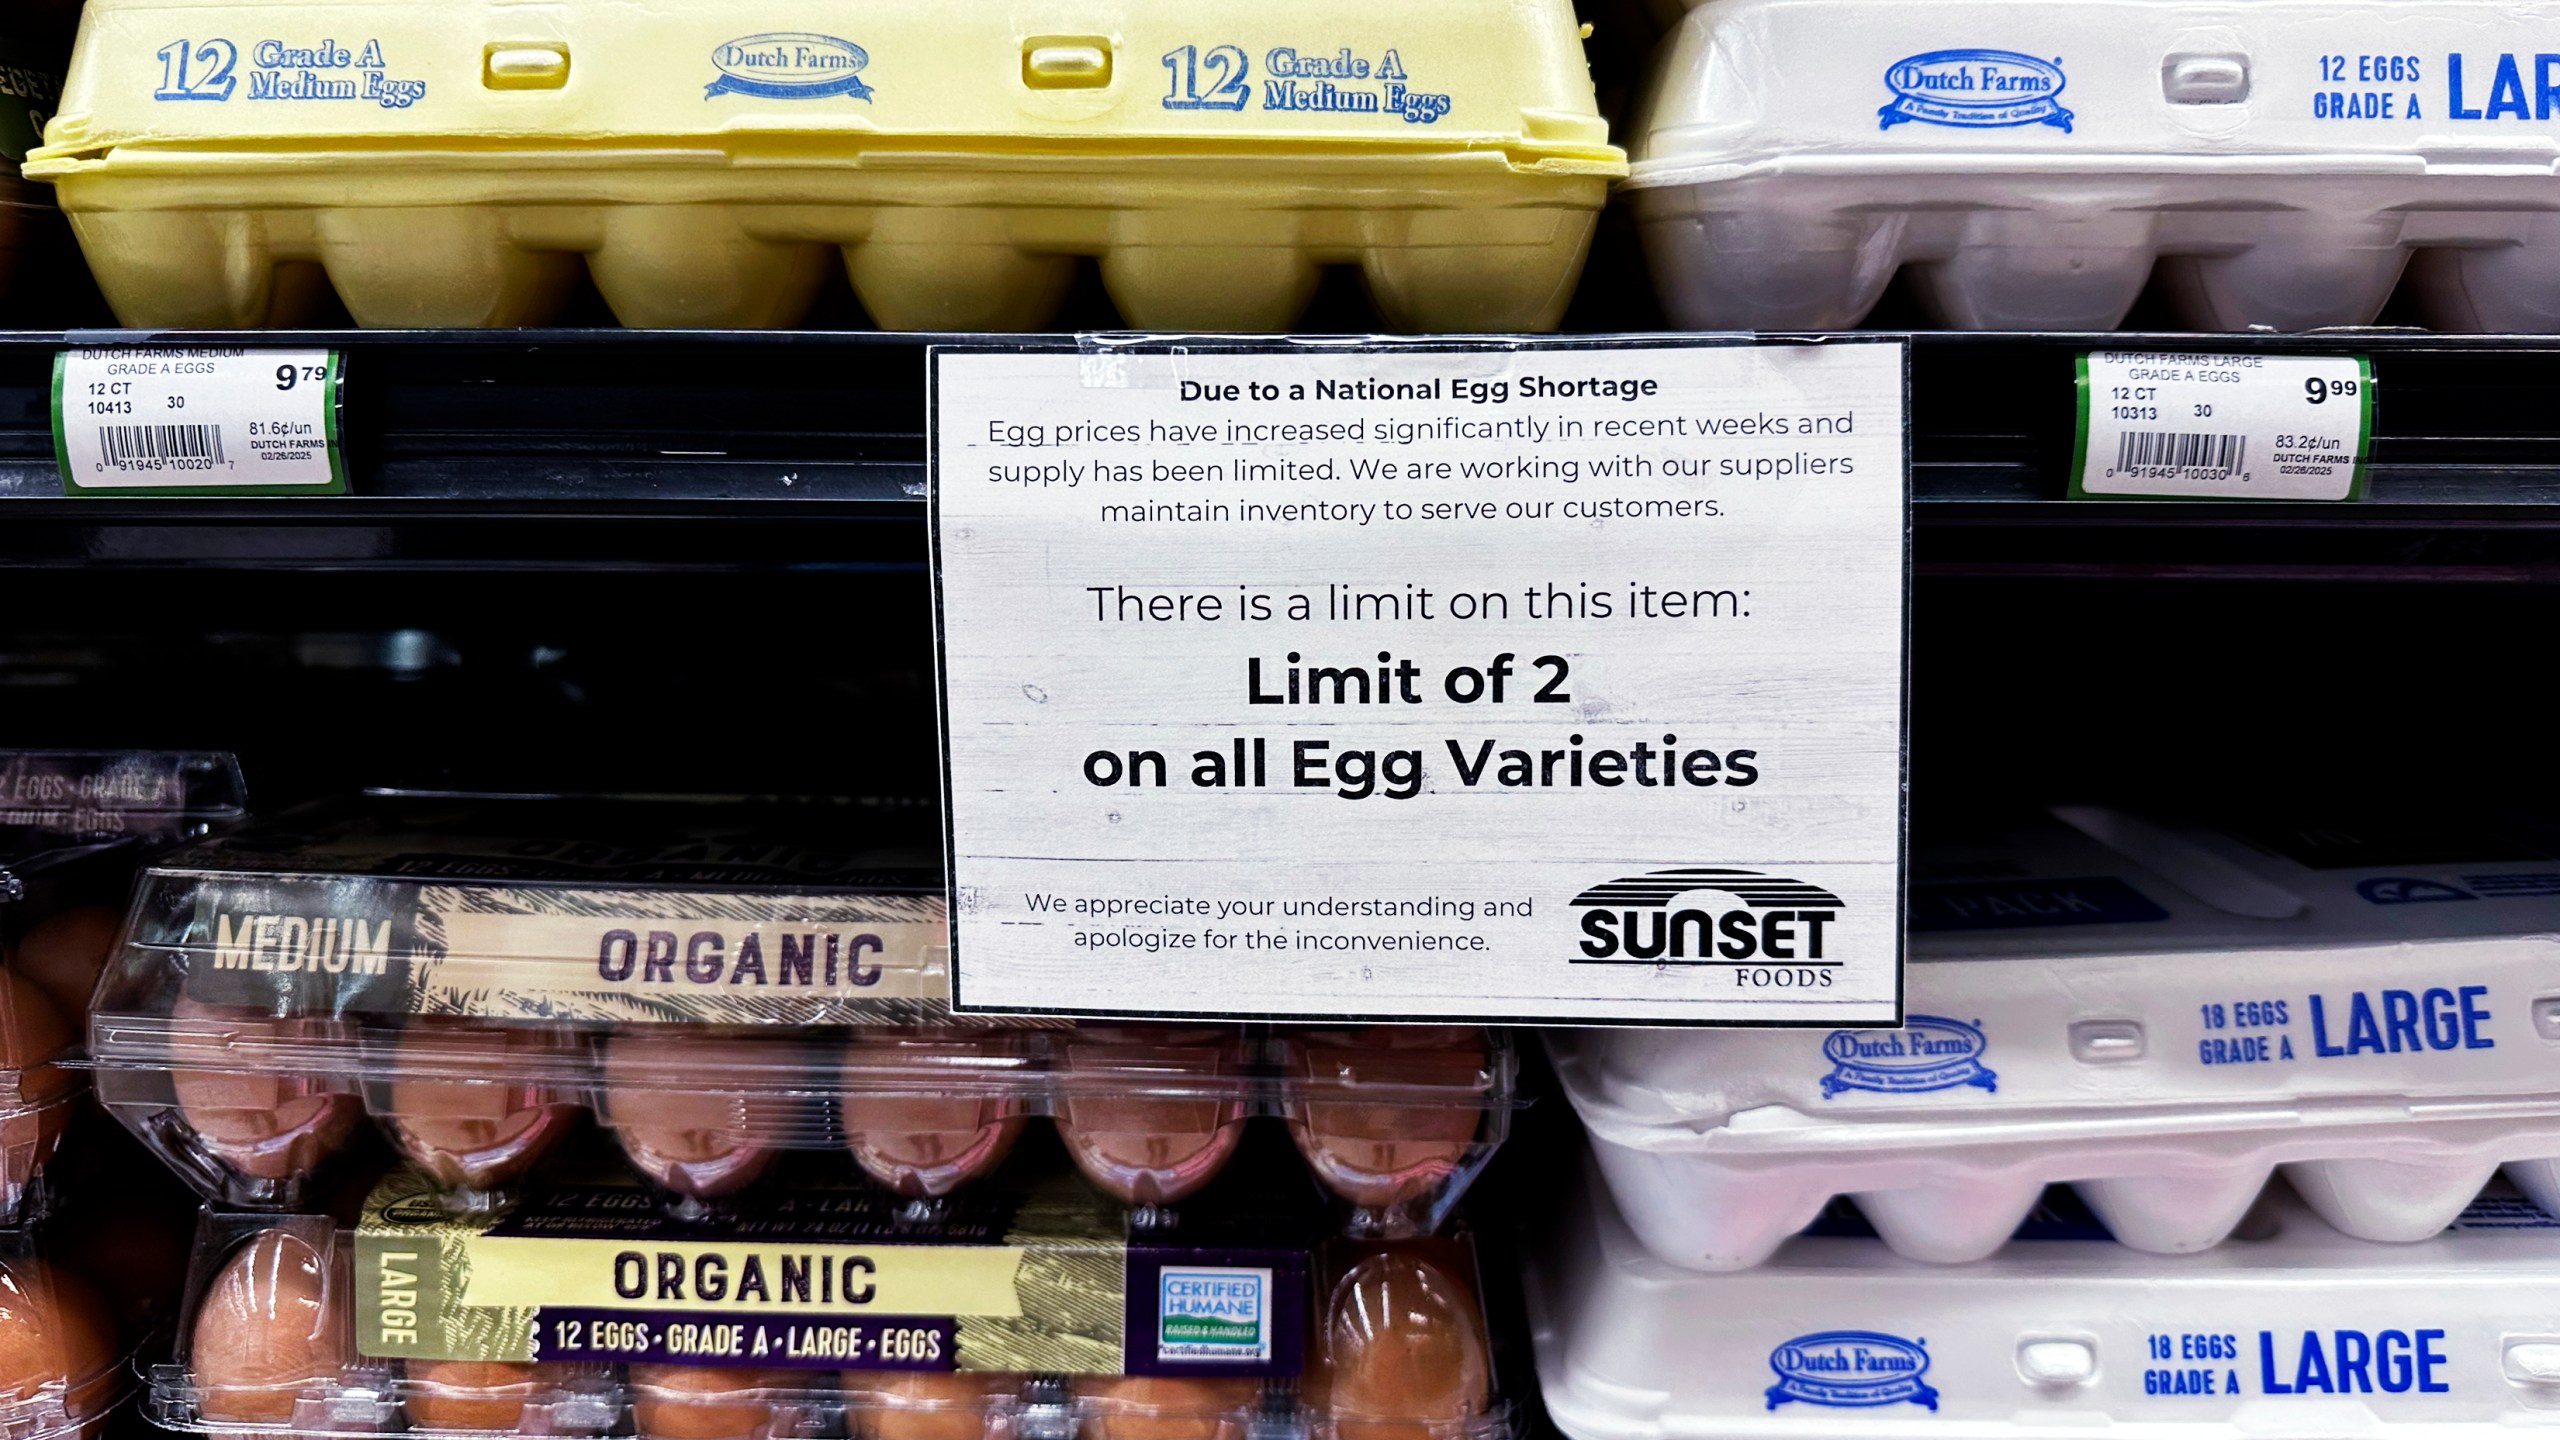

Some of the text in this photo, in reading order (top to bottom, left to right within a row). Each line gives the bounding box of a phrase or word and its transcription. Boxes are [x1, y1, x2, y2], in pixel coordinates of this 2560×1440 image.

[254, 39, 385, 68] Grade A
[725, 45, 856, 68] Dutch Farms
[1266, 48, 1407, 80] Grade A
[155, 38, 237, 101] 12
[1162, 44, 1250, 111] 12
[1901, 66, 2050, 91] Dutch Farms
[2320, 55, 2420, 81] 12 EGGS
[248, 71, 425, 108] Medium Eggs
[1264, 80, 1450, 124] Medium Eggs
[2314, 92, 2421, 119] GRADE A
[82, 349, 244, 360] DUTCH FARMS MEDIUM
[2104, 353, 2263, 368] DUTCH FARMS LARGE
[108, 363, 215, 375] GRADE A EGGS
[276, 364, 326, 390] 9 79
[2129, 369, 2240, 383] GRADE A EGGS
[88, 382, 132, 395] 12 CT
[1180, 375, 1658, 405] Due to a National Egg Shortage
[2112, 388, 2156, 400] 12 CT
[2304, 377, 2357, 404] 9 99
[88, 402, 132, 414] 10413
[168, 396, 184, 408] 30
[2112, 407, 2157, 420] 10313
[2194, 405, 2212, 417] 30
[250, 422, 312, 438] 81.6¢/un
[989, 410, 1853, 448] Egg prices have increased significantly in recent weeks and
[251, 440, 325, 449] DUTCH FARMS
[262, 452, 312, 460] 02/26/2025
[2276, 435, 2340, 451] 83.2¢/un
[96, 458, 234, 472] 0 91945 10020 7
[989, 452, 1854, 488] supply has been limited. We are working with our suppliers
[2273, 454, 2350, 464] DUTCH FARMS
[2106, 467, 2250, 482] 0 91945 10030 6
[1101, 497, 1724, 526] maintain inventory to serve our customers.
[1086, 581, 1750, 622] There is a limit on this item:
[1248, 650, 1571, 705] Limit of 2
[1083, 733, 1759, 801] on all Egg Varieties
[1025, 893, 1532, 921] We appreciate your understanding and
[213, 914, 392, 975] MEDIUM
[1074, 927, 1490, 953] apologize for the inconvenience.
[598, 929, 884, 987] ORGANIC
[1735, 968, 1832, 987] FOODS
[2200, 1000, 2289, 1029] 18 EGGS
[2308, 986, 2494, 1058] LARGE
[1838, 1032, 1973, 1058] Dutch Farms
[2199, 1034, 2294, 1064] GRADE A
[614, 1250, 877, 1304] ORGANIC
[1168, 1281, 1255, 1297] CERTIFIED
[379, 1251, 418, 1345] LARGE
[1169, 1298, 1253, 1315] HUMANE
[554, 1320, 941, 1361] 12 EGGS GRADE A LARGE EGGS
[2148, 1334, 2236, 1360] 18 EGGS
[1784, 1348, 1916, 1371] Dutch Farms
[2259, 1329, 2449, 1394] LARGE
[2144, 1369, 2239, 1395] GRADE A
